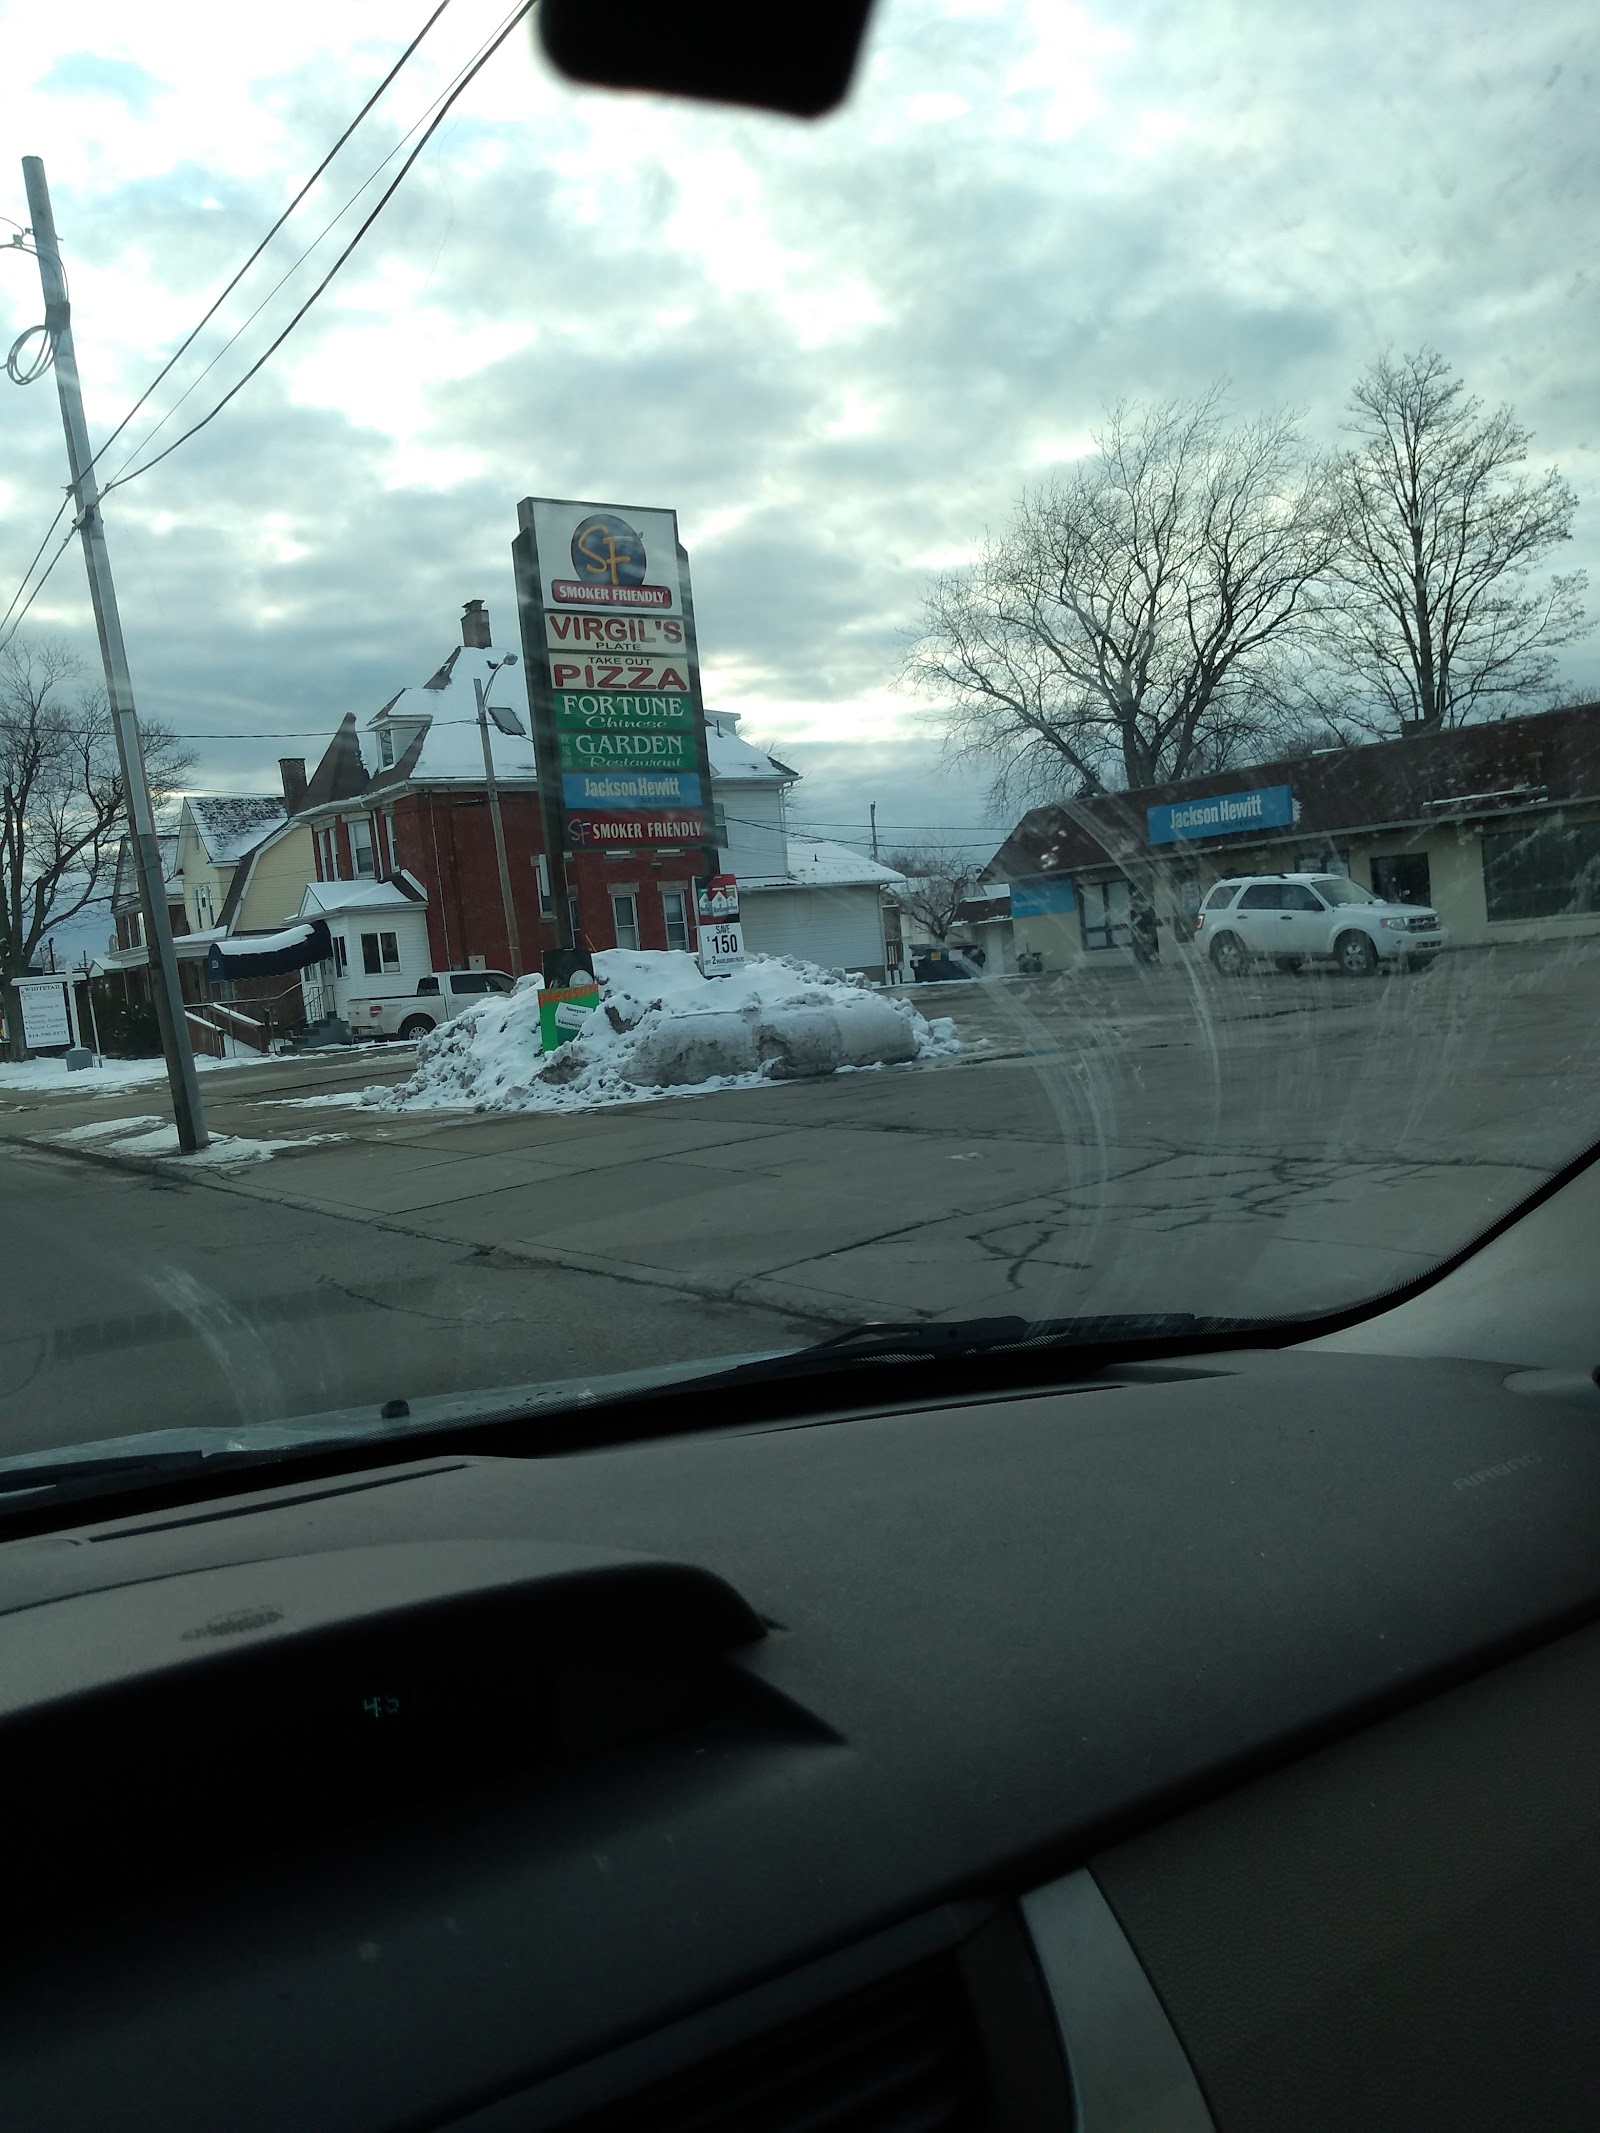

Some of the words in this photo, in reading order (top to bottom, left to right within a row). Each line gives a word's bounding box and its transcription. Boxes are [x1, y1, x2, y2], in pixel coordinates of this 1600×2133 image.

[559, 585, 610, 601] SMOKER
[612, 586, 665, 603] FRIENDLY
[549, 616, 683, 645] VIRGIL'S
[595, 641, 641, 651] PLATE
[588, 656, 621, 665] TAKE
[624, 657, 652, 666] OUT
[553, 664, 688, 690] PIZZA
[563, 696, 684, 717] FORTUNE
[585, 716, 668, 729] Chinese
[575, 735, 683, 755] GARDEN
[581, 756, 682, 768] Restaurant
[585, 778, 637, 797] Jackson
[639, 778, 680, 796] Hewitt
[1170, 806, 1219, 829] Jackson
[1219, 795, 1262, 821] Hewitt
[592, 822, 643, 840] SMOKER
[647, 821, 702, 838] FRIENDLY
[716, 925, 730, 934] SAVE
[711, 956, 717, 965] 2
